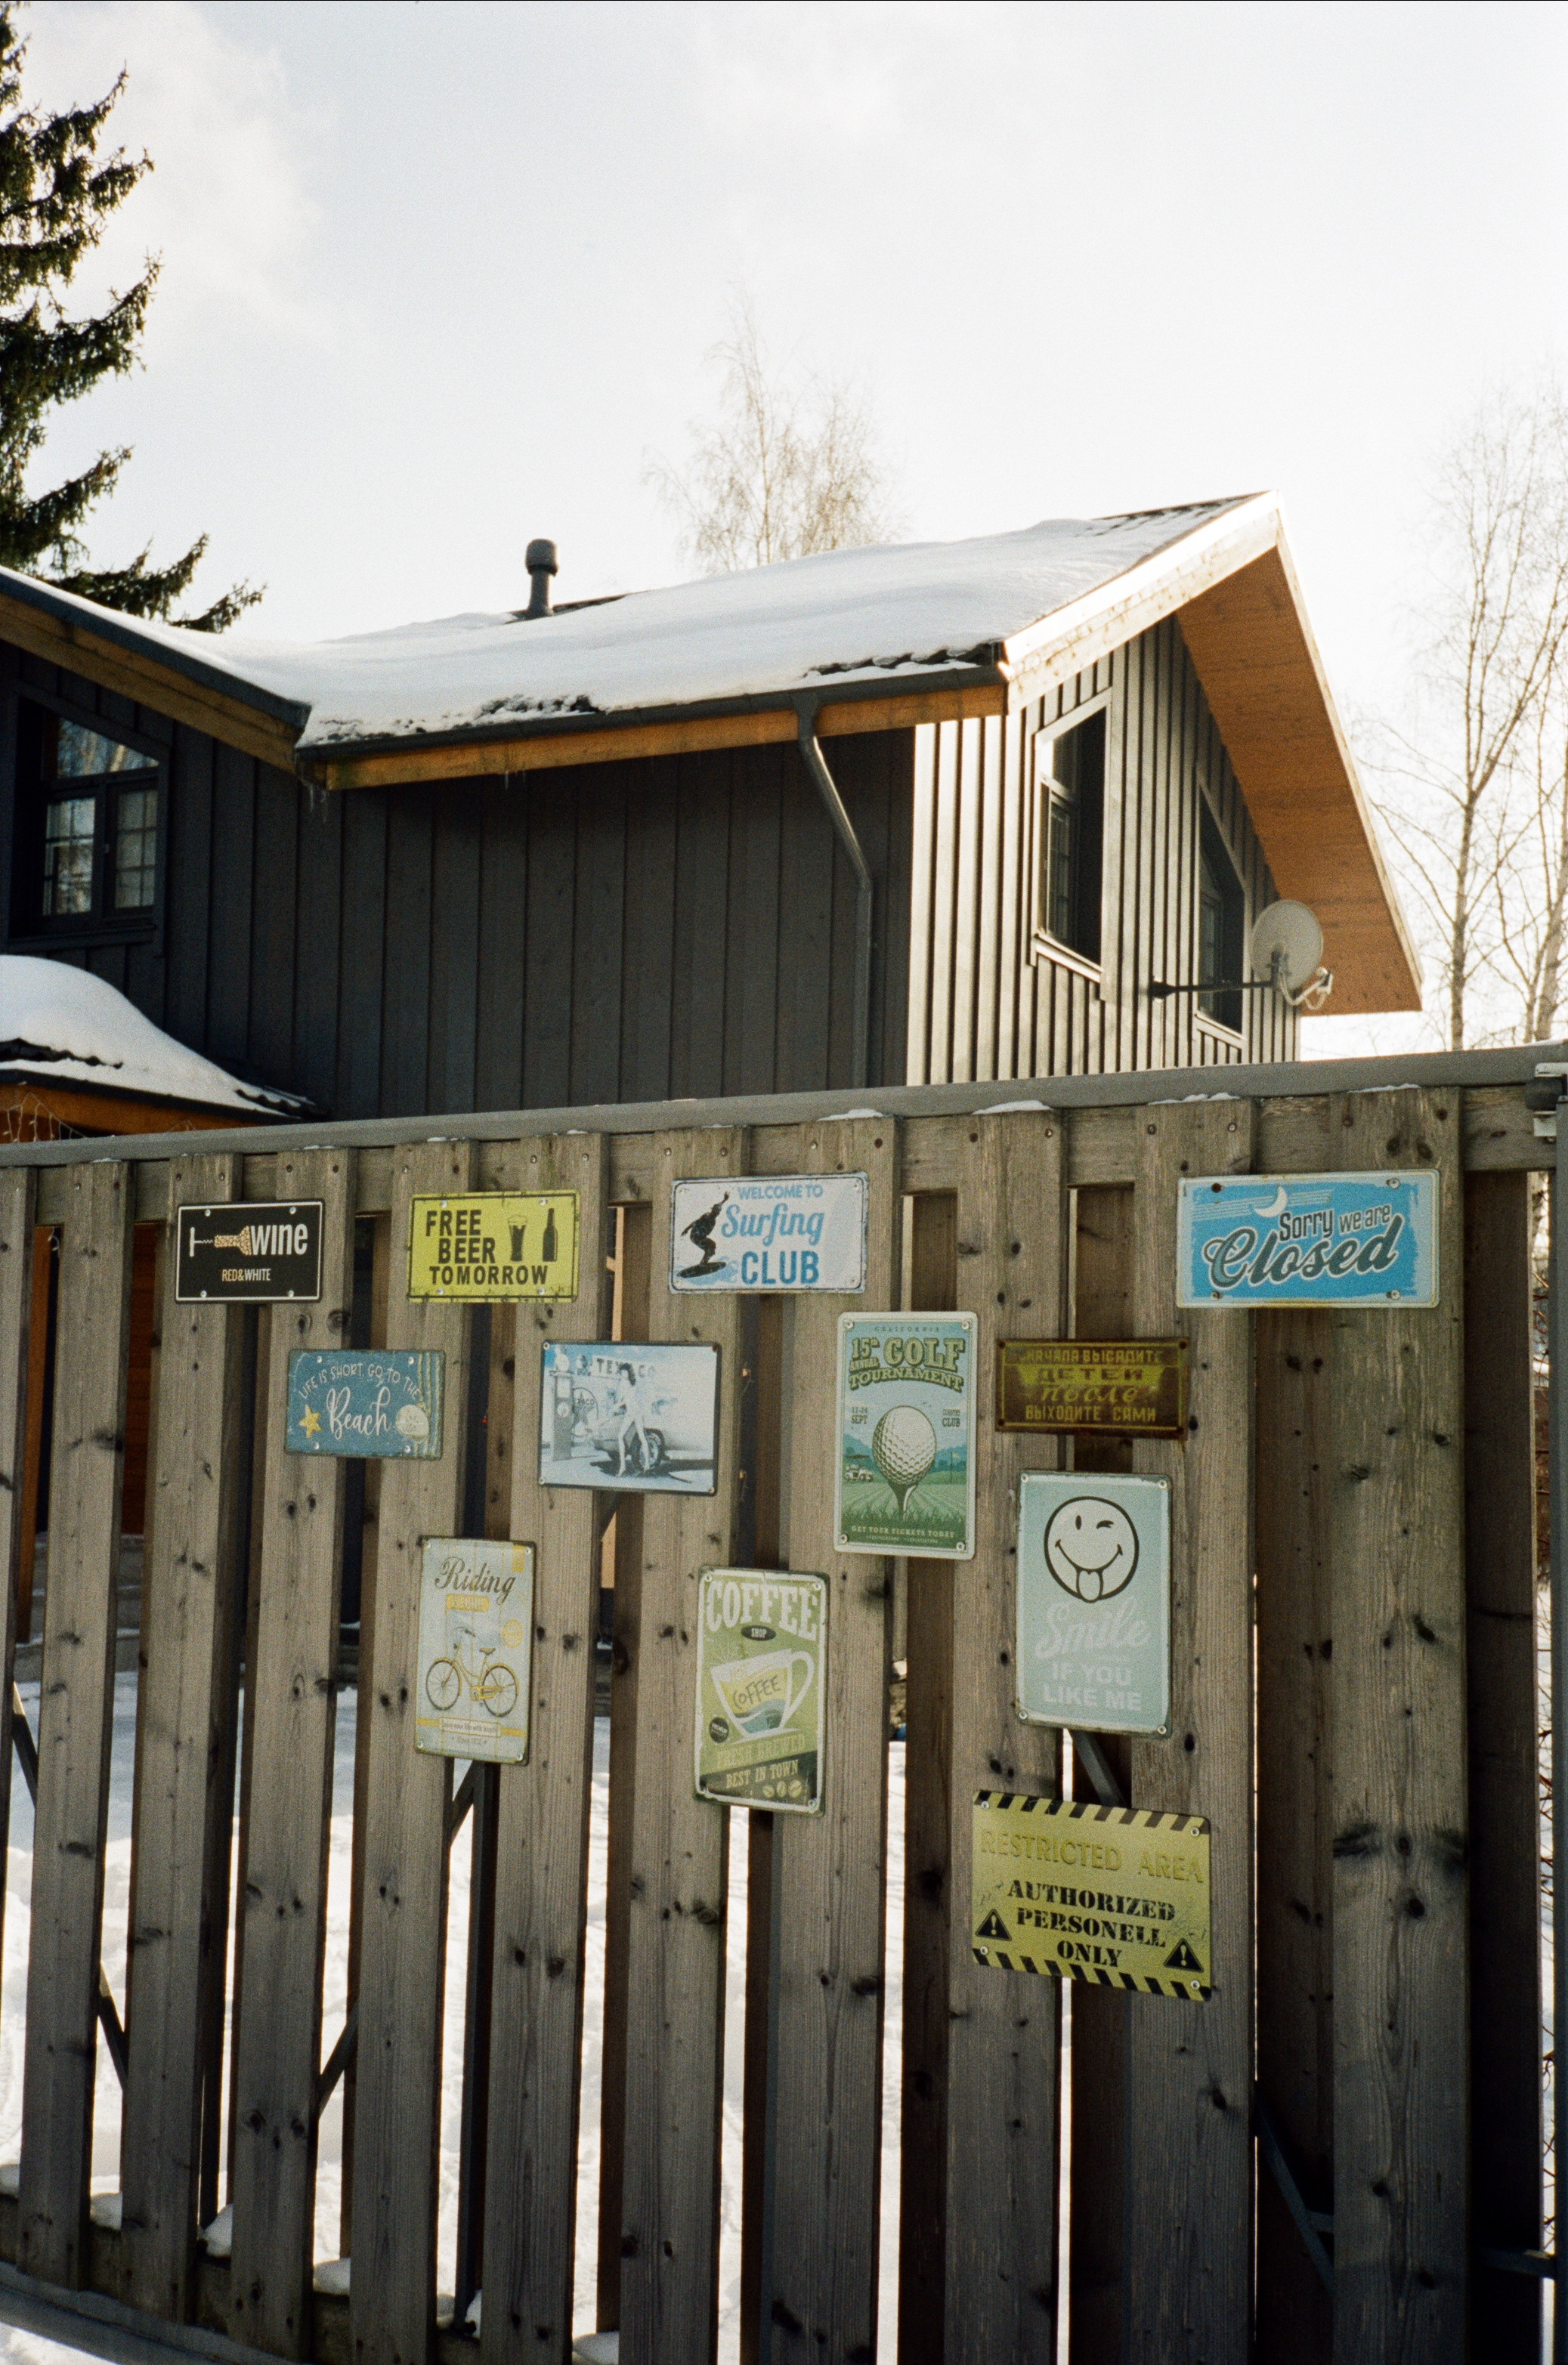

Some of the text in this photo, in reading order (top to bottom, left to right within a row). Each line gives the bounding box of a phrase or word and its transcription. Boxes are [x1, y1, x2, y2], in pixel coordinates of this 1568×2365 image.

[738, 1184, 824, 1200] WELCOME TO
[425, 1209, 482, 1237] FREE
[721, 1203, 824, 1247] Surfing
[1279, 1203, 1392, 1242] Sorry we are
[251, 1223, 308, 1255] wine
[438, 1237, 496, 1264] BEER
[1202, 1213, 1405, 1290] Closed
[221, 1268, 271, 1281] RED&WHITE
[429, 1265, 549, 1285] TOMORROW
[741, 1251, 819, 1285] CLUB
[597, 1358, 656, 1379] TEXCO
[883, 1337, 966, 1373] GOLF
[298, 1375, 319, 1399] LIFE
[319, 1368, 328, 1383] IS
[368, 1364, 383, 1378] GO
[387, 1366, 401, 1383] TO
[403, 1376, 421, 1399] THE
[849, 1366, 964, 1393] TOURNAMENT
[326, 1386, 391, 1440] Beach
[942, 1417, 960, 1427] CLUB
[1025, 1405, 1156, 1422] ВЫХОДИТЕ САМИ
[851, 1525, 954, 1538] GET YOUR TICKETS TODAY
[435, 1556, 517, 1606] Riding
[706, 1580, 818, 1642] COFFEE
[751, 1628, 767, 1638] SHOP
[1035, 1596, 1151, 1659] Smile
[1052, 1662, 1132, 1686] IF YOU
[1044, 1683, 1141, 1711] LIKE ME
[725, 1759, 799, 1789] BEST IN TOWN
[981, 1830, 1205, 1883] RESTRICTED AREA
[1007, 1879, 1176, 1921] AUTHORIZED
[1016, 1907, 1167, 1948] PERSONELL
[1057, 1940, 1123, 1968] ONLY
